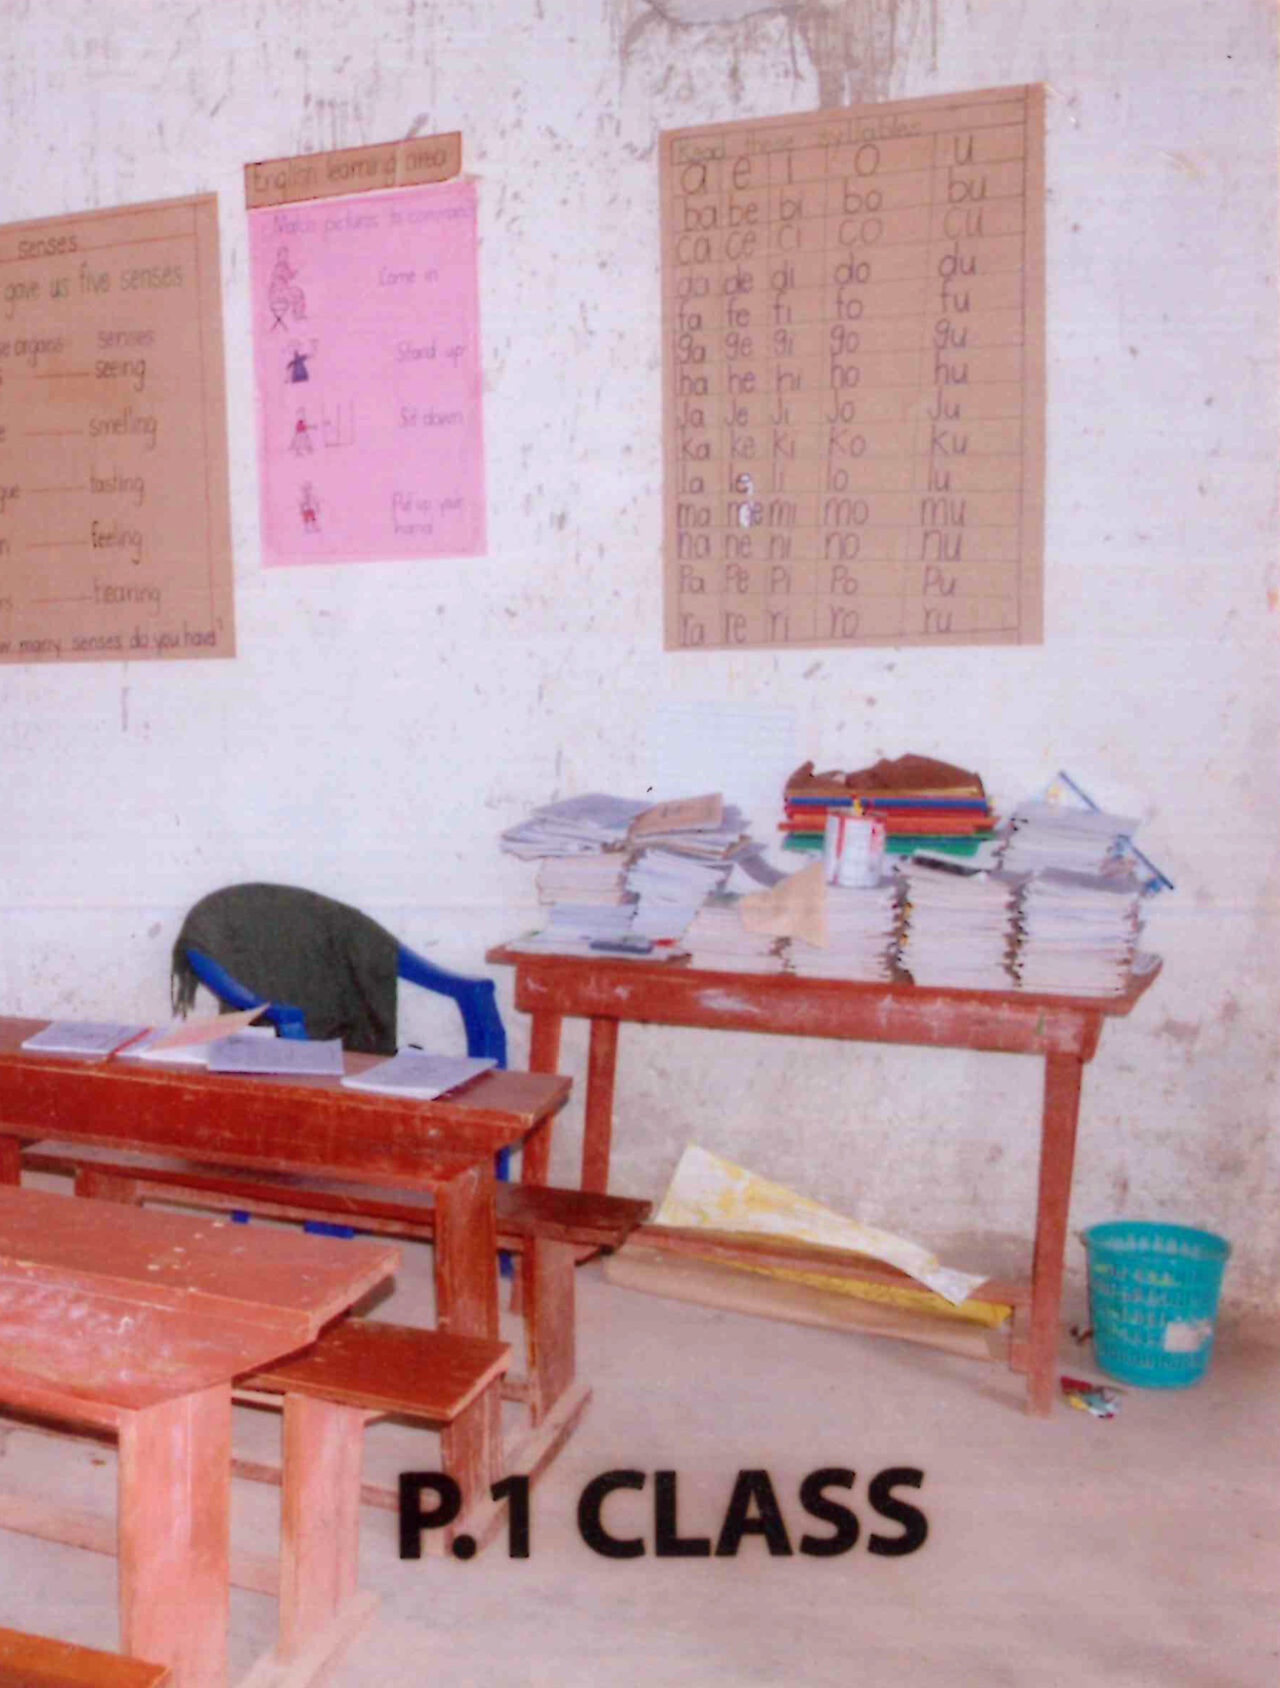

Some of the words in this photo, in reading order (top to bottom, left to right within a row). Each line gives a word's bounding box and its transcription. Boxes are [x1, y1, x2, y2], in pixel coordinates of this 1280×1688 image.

[682, 162, 708, 194] a
[733, 153, 751, 190] e
[954, 134, 974, 166] u
[684, 193, 718, 231] ba
[730, 193, 758, 226] be
[844, 175, 882, 214] bo
[949, 165, 987, 203] bu
[18, 236, 78, 260] senses
[677, 236, 710, 264] ca
[726, 230, 756, 260] ce
[945, 206, 984, 239] cu
[725, 265, 754, 294] de
[834, 250, 871, 284] do
[939, 241, 976, 279] du
[4, 281, 40, 320] gave
[49, 278, 71, 298] us
[79, 261, 111, 293] five
[120, 266, 183, 291] senses
[678, 298, 703, 331] fa
[726, 297, 750, 327] fe
[835, 286, 863, 319] fo
[941, 278, 970, 313] fu
[98, 330, 154, 350] senses
[678, 333, 707, 364] ga
[726, 331, 753, 360] ge
[830, 324, 860, 356] go
[933, 319, 968, 350] gu
[95, 358, 147, 392] seeing
[680, 365, 708, 396] ha
[728, 363, 755, 394] he
[830, 353, 861, 389] ho
[933, 352, 969, 385] hu
[89, 474, 145, 508] tasting
[681, 461, 704, 494] la
[827, 458, 849, 492] lo
[928, 455, 950, 492] lu
[677, 501, 711, 527] ma
[824, 496, 870, 526] mo
[921, 497, 966, 528] mu
[90, 520, 143, 565] feeling
[678, 530, 711, 559] na
[725, 533, 751, 560] ne
[825, 531, 860, 561] no
[922, 529, 962, 562] nu
[72, 632, 123, 652] senses
[129, 625, 149, 650] do
[152, 632, 180, 656] you
[680, 610, 705, 647] ra
[724, 610, 747, 643] re
[830, 602, 860, 639] ro
[923, 607, 953, 635] ru
